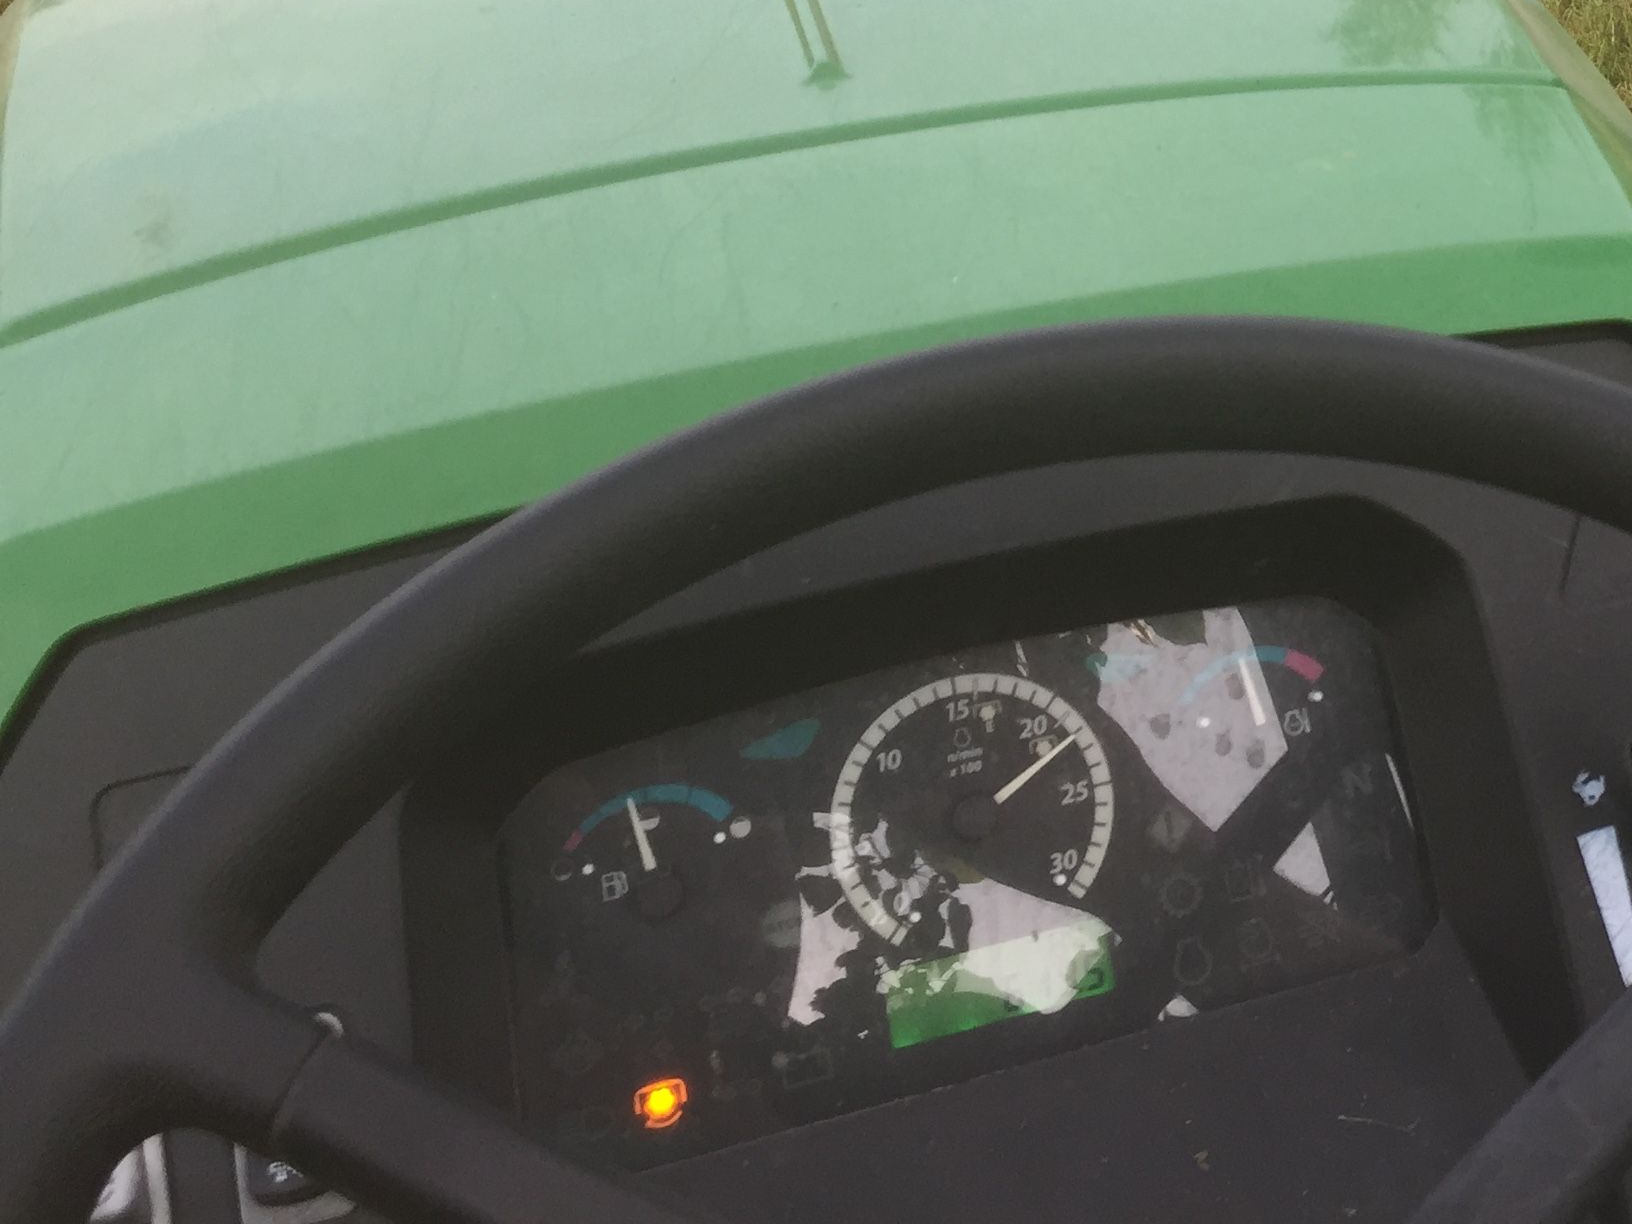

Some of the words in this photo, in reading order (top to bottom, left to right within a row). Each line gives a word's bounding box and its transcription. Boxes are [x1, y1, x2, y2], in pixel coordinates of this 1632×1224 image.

[946, 699, 969, 722] 15
[1018, 714, 1048, 739] 20
[876, 749, 902, 773] 10
[1060, 782, 1089, 805] 25
[1050, 849, 1078, 873] 30
